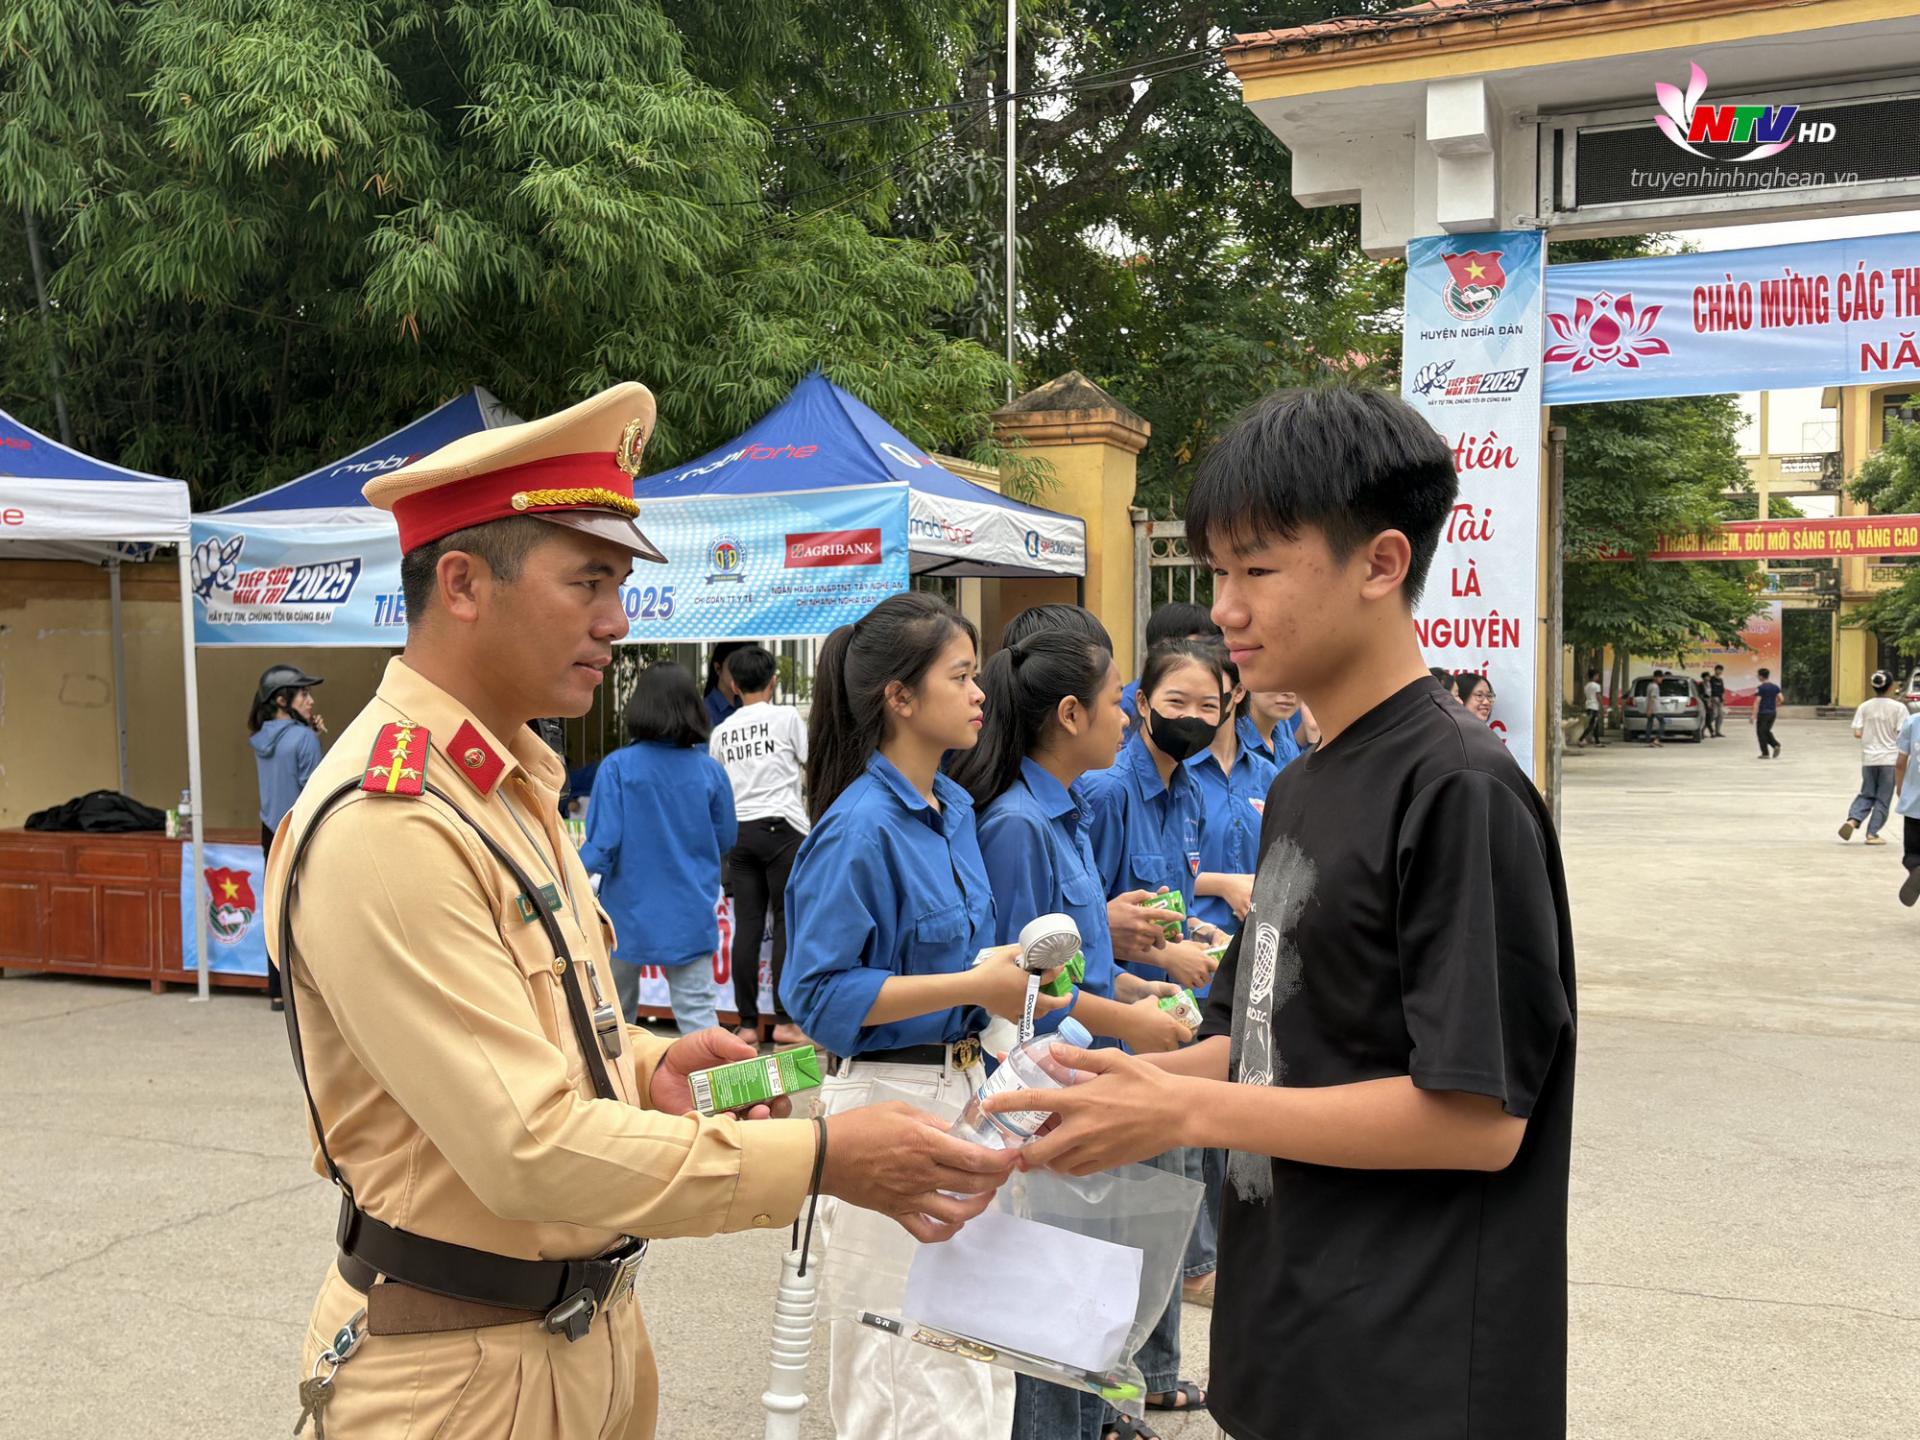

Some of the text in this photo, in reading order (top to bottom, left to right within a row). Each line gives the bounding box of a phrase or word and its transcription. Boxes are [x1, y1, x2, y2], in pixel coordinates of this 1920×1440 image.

[1693, 273, 1753, 333] CHÀO
[1760, 268, 1829, 329] MỪNG
[1837, 261, 1884, 323] CÁC
[1420, 323, 1523, 341] HUYỆN NGHĨA ĐÀN
[1480, 369, 1524, 393] 2025
[1446, 504, 1495, 543] Tài
[1745, 525, 1765, 551] ĐỔI
[1768, 527, 1790, 551] MỚI
[1793, 526, 1825, 550] SÁNG
[1829, 530, 1853, 553] TẠO,
[1857, 524, 1891, 548] NÂNG
[1894, 527, 1918, 547] CAO
[804, 542, 874, 557] AGRIBANK
[286, 561, 354, 601] 2025
[1451, 558, 1481, 597] LÀ
[260, 588, 286, 604] THI
[620, 586, 676, 620] 025
[1414, 610, 1520, 648] NGUYÊN
[721, 722, 768, 746] RALPH
